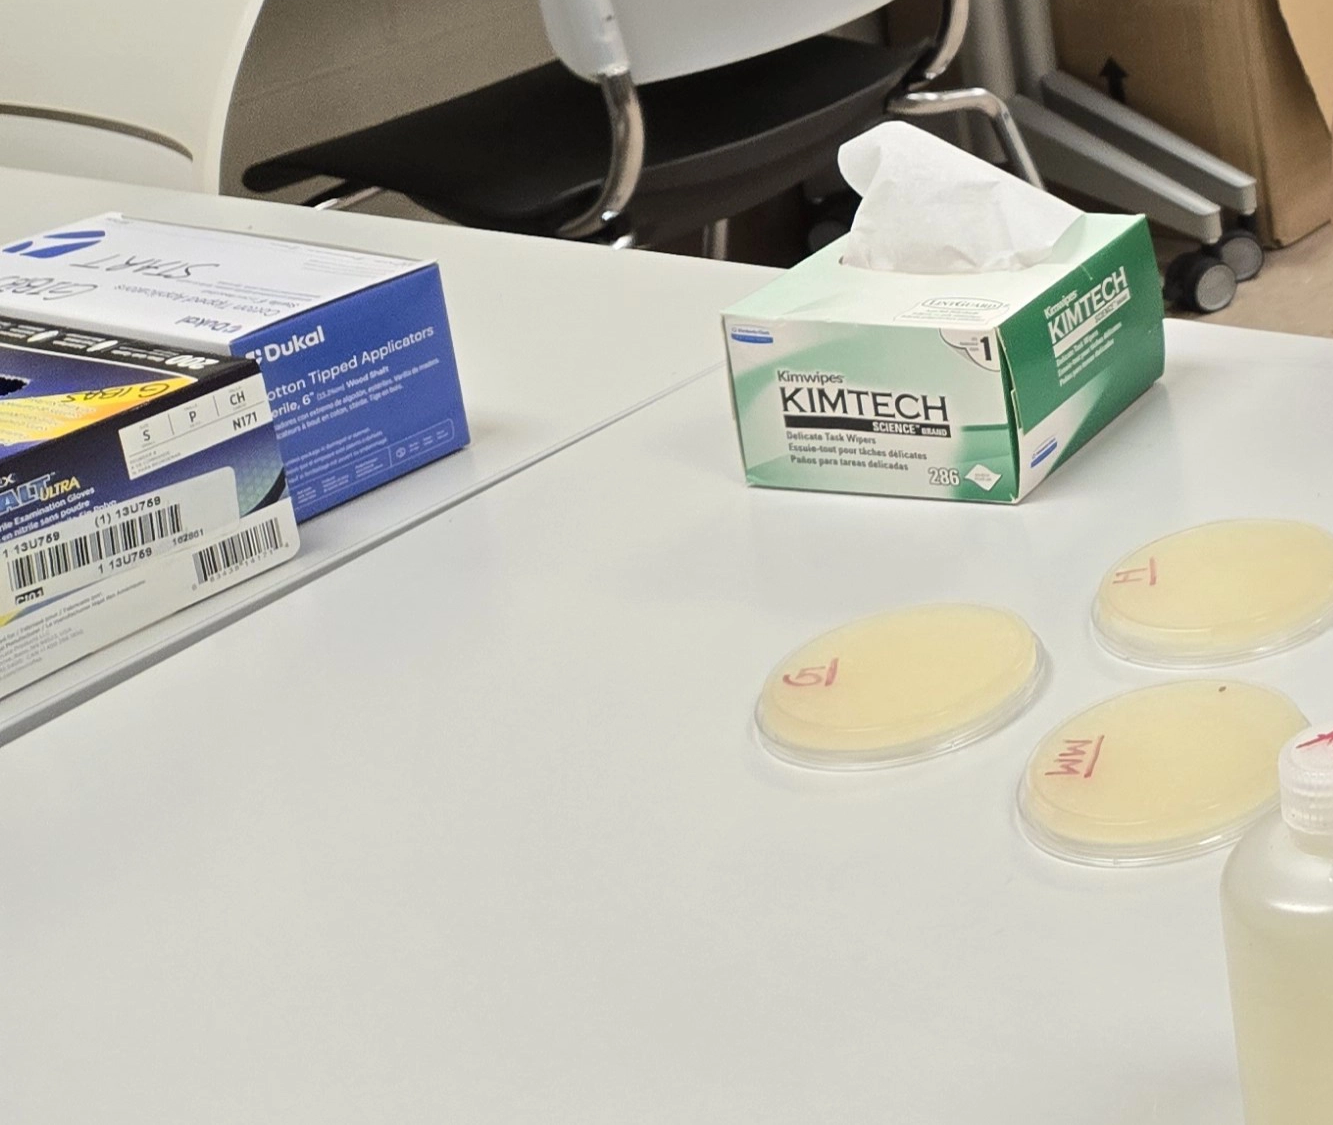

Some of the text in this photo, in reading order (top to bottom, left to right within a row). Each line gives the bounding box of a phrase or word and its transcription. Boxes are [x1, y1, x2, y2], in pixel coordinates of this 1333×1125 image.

[1043, 289, 1079, 320] Kimwipes
[1047, 265, 1129, 345] KIMTECH
[264, 325, 326, 363] Dukal
[979, 336, 992, 361] 1
[268, 325, 435, 401] otton Tipped Applicators
[777, 370, 844, 384] Kimwipes
[229, 390, 246, 407] CH
[779, 386, 949, 422] KIMTECH
[189, 410, 198, 424] P
[272, 401, 301, 419] erile,
[232, 411, 258, 432] N171
[142, 429, 151, 442] S
[786, 431, 877, 446] Delicate Task Wipers
[788, 442, 836, 455] Essuie-tout
[837, 445, 858, 458] pour
[818, 457, 838, 469] para
[839, 457, 867, 469] tareas
[867, 459, 909, 472] delicadas
[928, 467, 961, 487] 286
[39, 475, 81, 502] ULTRA
[14, 498, 67, 526] Examination
[67, 486, 96, 504] Gloves
[60, 499, 91, 522] poudre
[1043, 738, 1093, 777] MM
